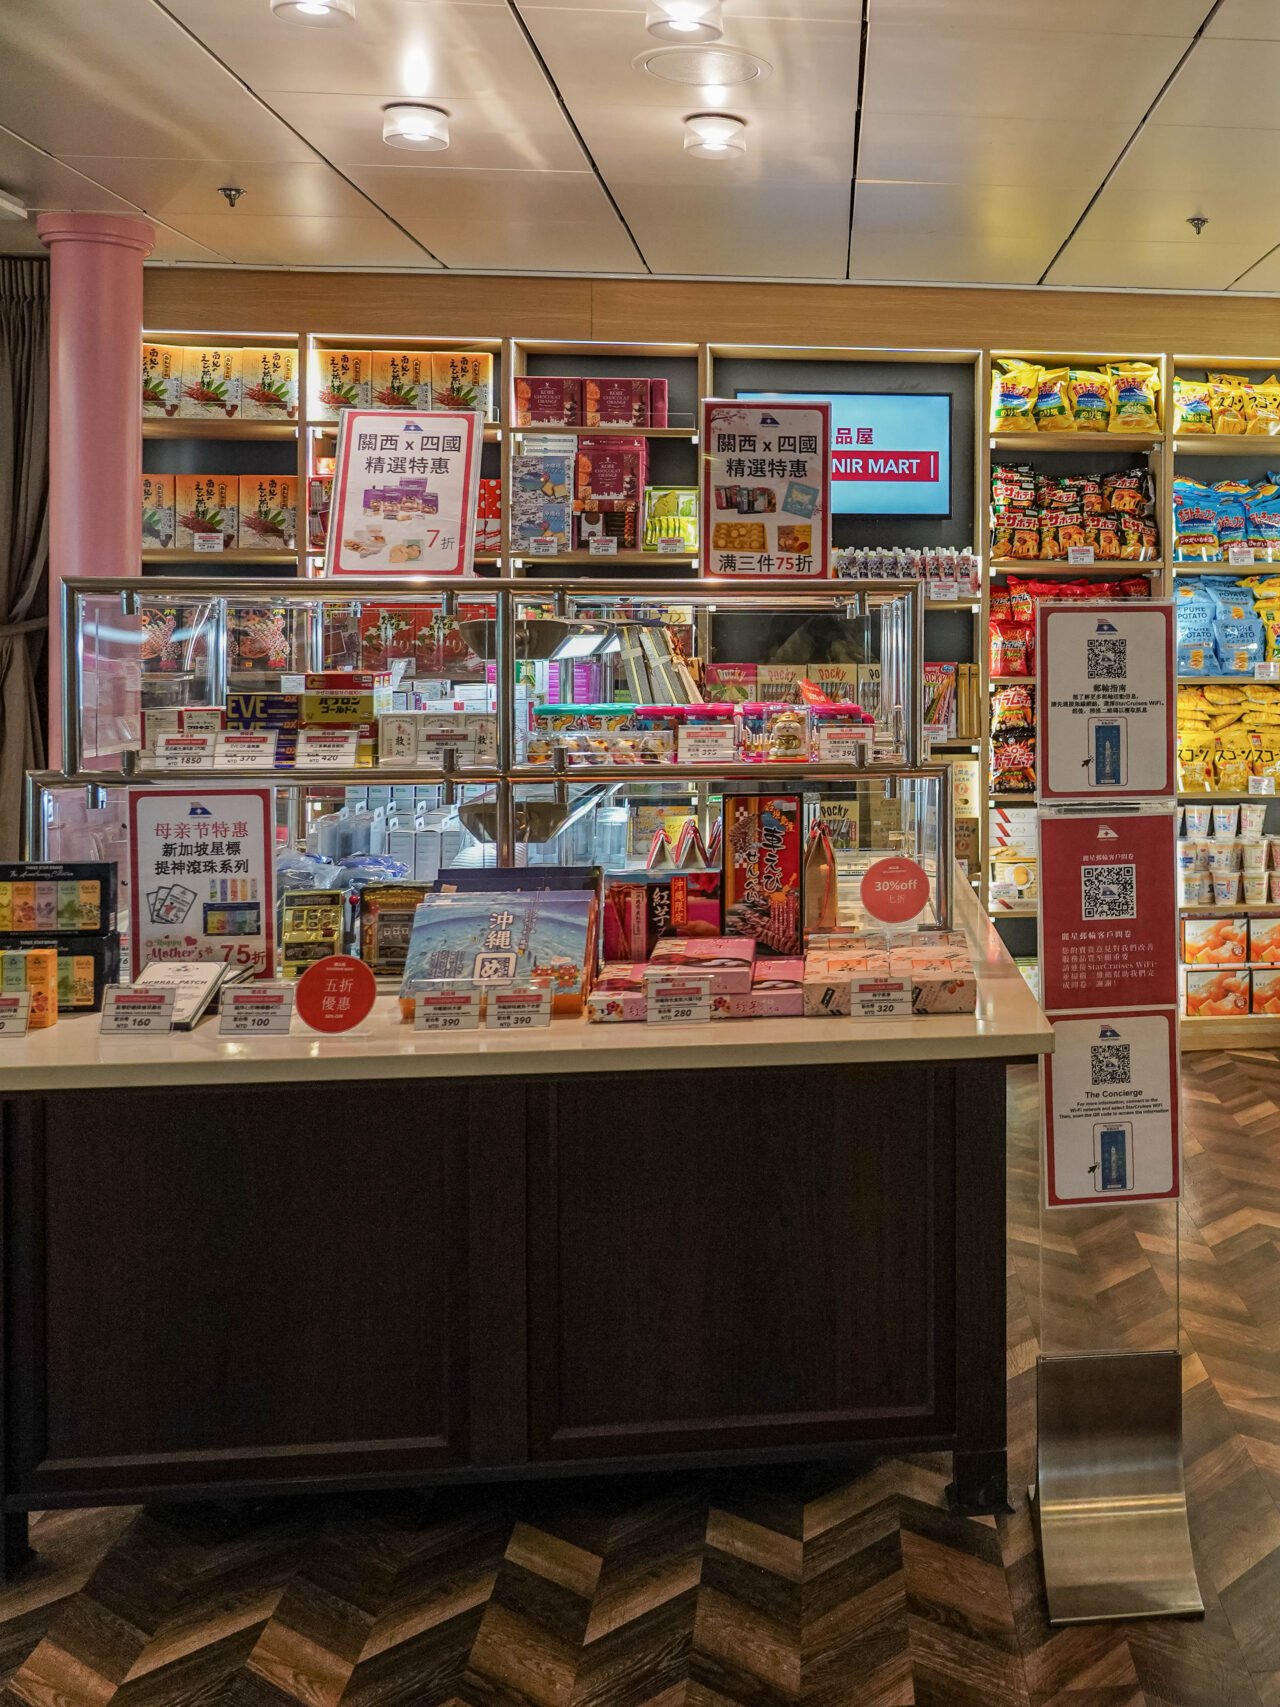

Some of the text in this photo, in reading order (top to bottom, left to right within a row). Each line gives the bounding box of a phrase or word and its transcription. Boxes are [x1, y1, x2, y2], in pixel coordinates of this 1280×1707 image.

[358, 433, 400, 452] 關西
[420, 435, 462, 452] 四國
[717, 433, 757, 454] 關西
[777, 435, 818, 454] 四國
[835, 427, 874, 445] 品屋
[364, 455, 450, 474] 精選特惠
[726, 458, 808, 478] 精選特惠
[868, 458, 921, 474] MART
[994, 513, 1040, 529] ピザポテト
[1038, 512, 1083, 528] ピザポテト
[717, 668, 747, 681] Pocky
[767, 668, 796, 682] Pocky
[818, 666, 848, 680] Pocky
[226, 695, 268, 719] EVE
[180, 756, 202, 764] 1850
[321, 753, 339, 761] 420
[1216, 749, 1252, 762] スコーン
[820, 803, 849, 818] Pocky
[153, 821, 249, 839] 母亲节特惠
[162, 841, 241, 857] 新加坡星標
[154, 858, 249, 875] 提神滾珠系列
[761, 826, 786, 894] 車えび
[744, 850, 761, 903] せんべい
[484, 909, 515, 950] 沖縄
[324, 978, 354, 993] 五折
[322, 996, 351, 1010] 優惠
[876, 1004, 895, 1013] 320
[513, 1016, 532, 1025] 390
[673, 1009, 692, 1018] 280
[132, 1018, 151, 1027] 160
[250, 1018, 270, 1027] 100
[441, 1018, 460, 1027] 390
[1085, 1088, 1143, 1099] The Concierge
